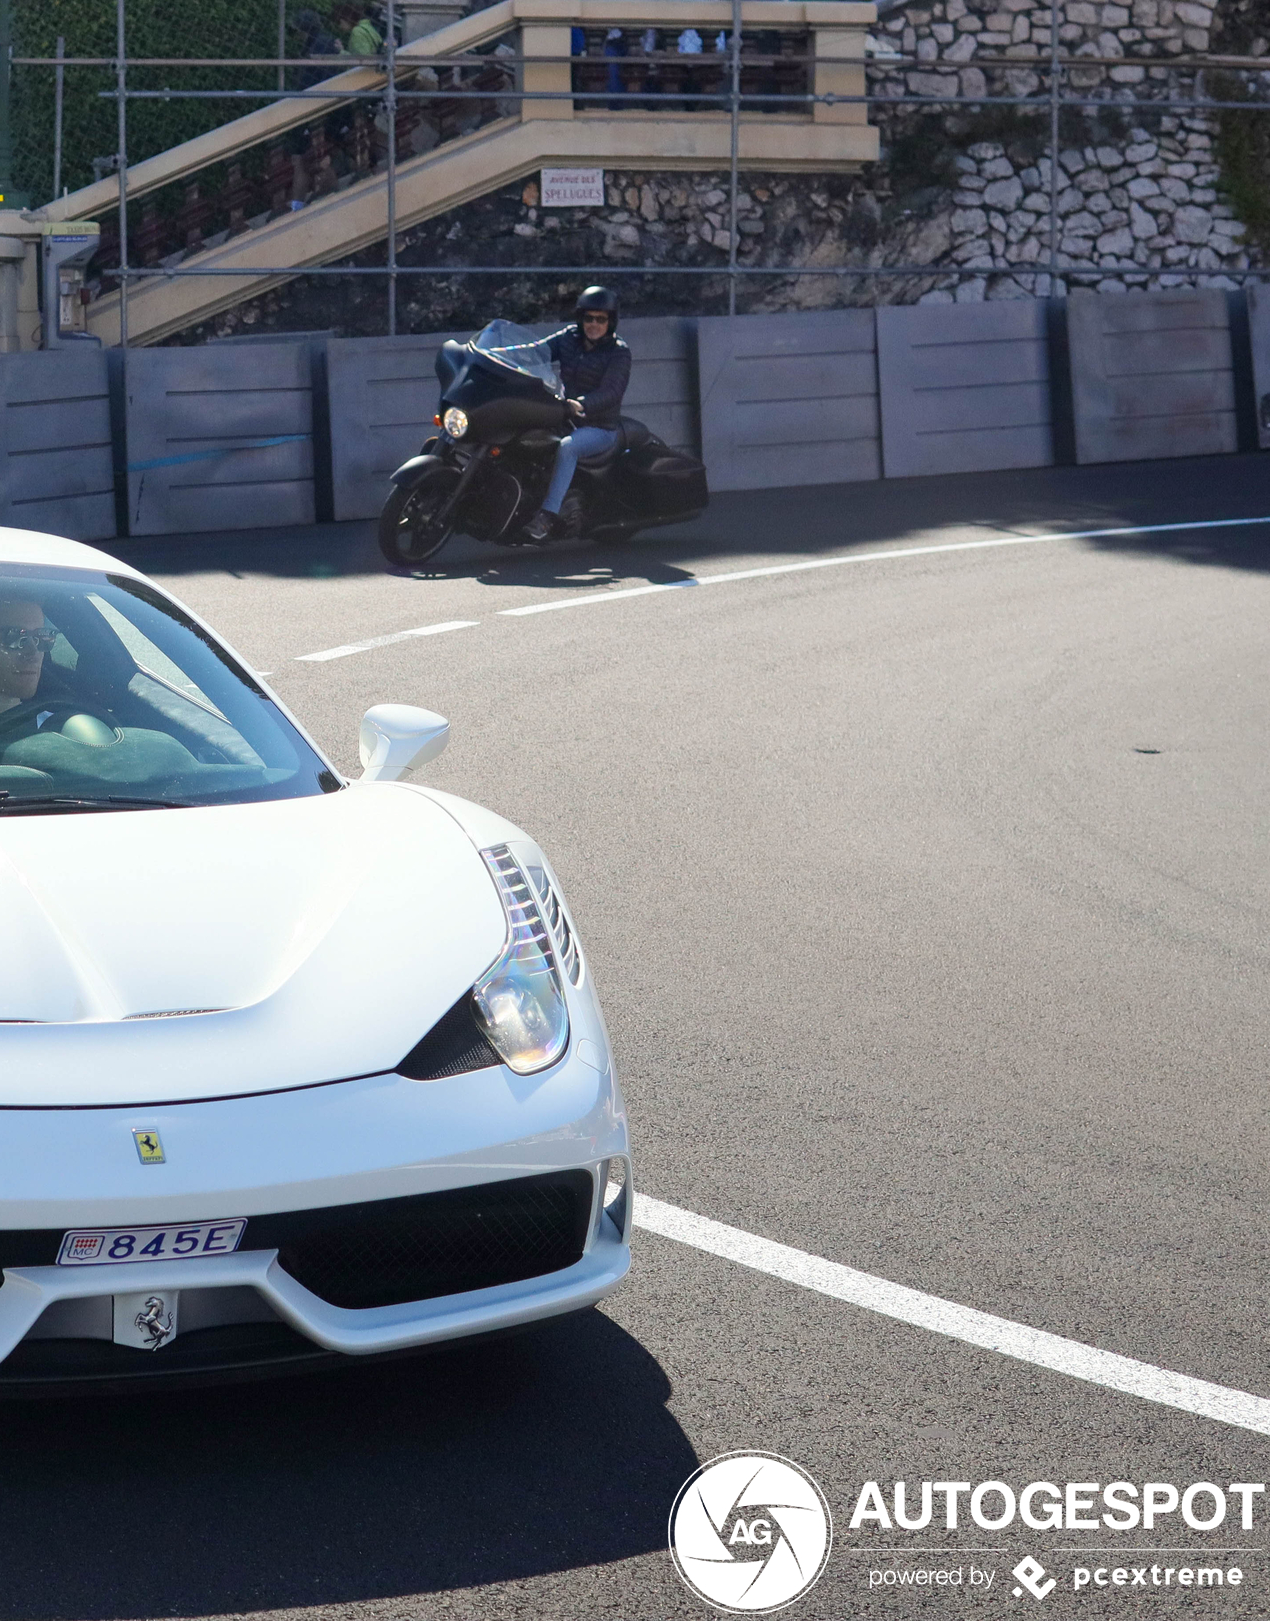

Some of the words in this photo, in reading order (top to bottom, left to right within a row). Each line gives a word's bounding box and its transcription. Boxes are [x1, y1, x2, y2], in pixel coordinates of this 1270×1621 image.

[550, 176, 578, 184] AVENUE
[581, 176, 596, 184] DES
[544, 188, 602, 200] SPELUGUES
[107, 1225, 236, 1260] 845E
[72, 1248, 93, 1257] MC
